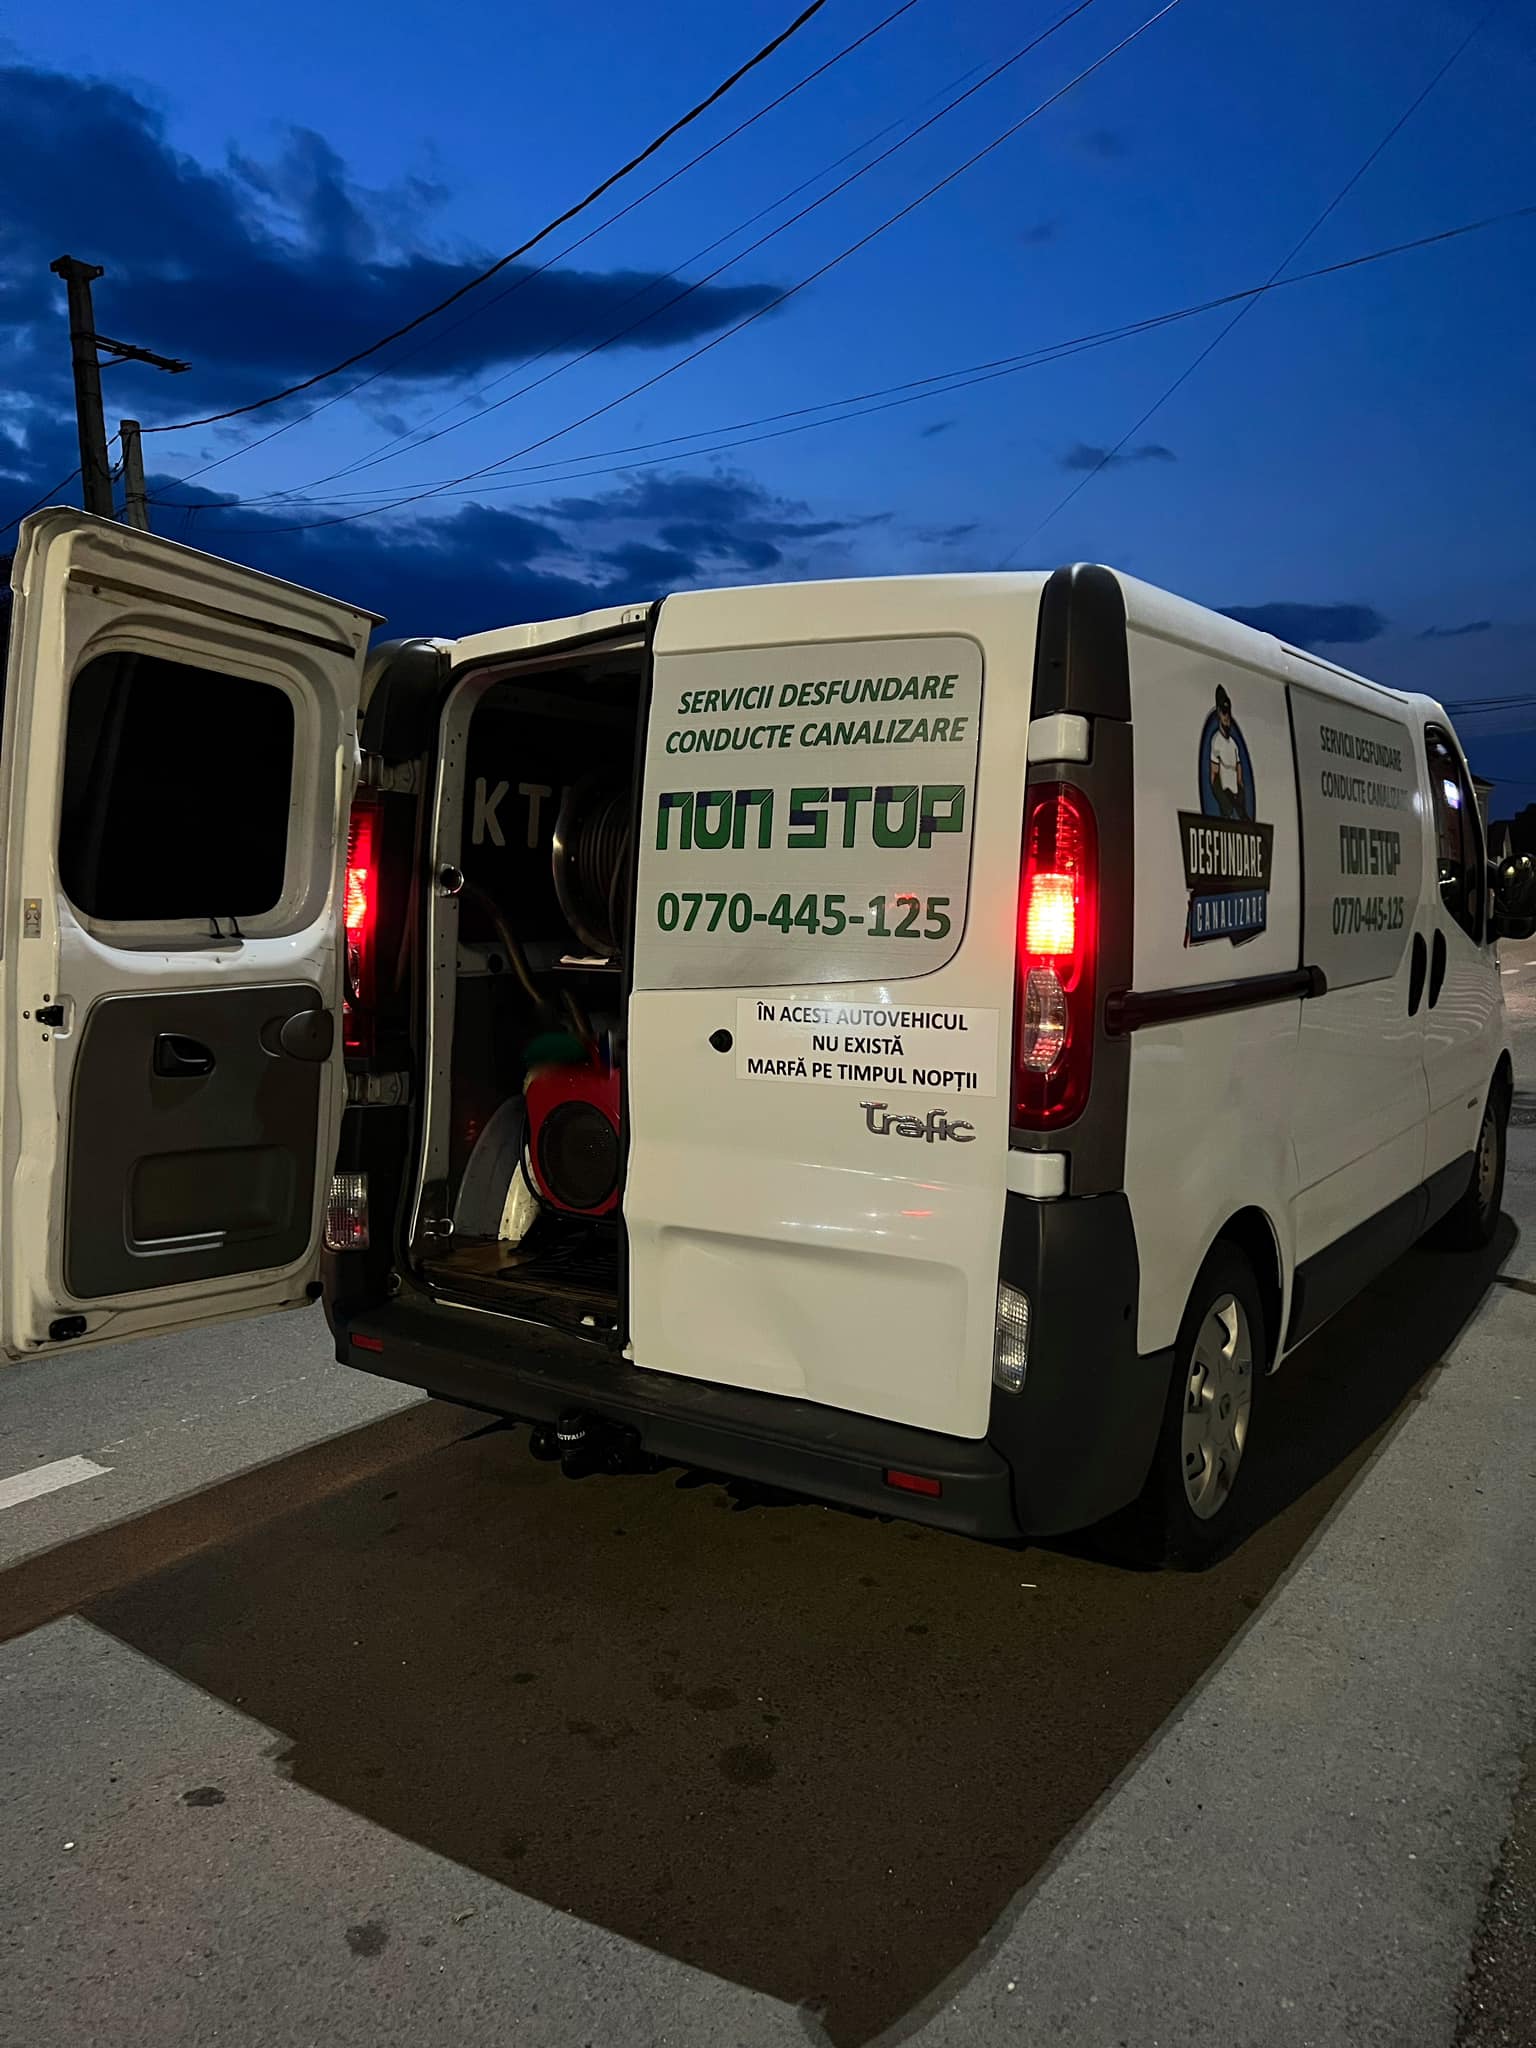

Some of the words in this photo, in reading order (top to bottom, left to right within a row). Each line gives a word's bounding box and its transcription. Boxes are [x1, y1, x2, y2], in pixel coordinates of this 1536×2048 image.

[678, 684, 774, 714] SERVICII
[778, 674, 959, 709] DESFUNDARE
[665, 724, 795, 754] CONDUCTE
[799, 717, 969, 747] CANALIZARE
[1320, 725, 1354, 759] SERVICII
[1356, 737, 1402, 772] DESFUNDARE
[1321, 771, 1366, 804] CONDUCTE
[656, 788, 774, 850] NON
[787, 784, 966, 849] STOP
[1189, 827, 1263, 878] DESFUNDARE
[1369, 829, 1401, 876] STOP
[657, 892, 951, 940] 0770-445-125
[1196, 895, 1264, 932] CANALIZARE
[1333, 897, 1404, 935] 0770-445-125
[757, 1001, 775, 1021] ÎN
[780, 1005, 832, 1026] ACEST
[837, 1008, 968, 1031] AUTOVEHICUL
[812, 1035, 839, 1052] NU
[844, 1035, 904, 1056] EXISTĂ
[747, 1057, 807, 1078] MARFĂ
[812, 1062, 832, 1079] PE
[837, 1063, 907, 1084] TIMPUL
[860, 1100, 976, 1143] Trafic
